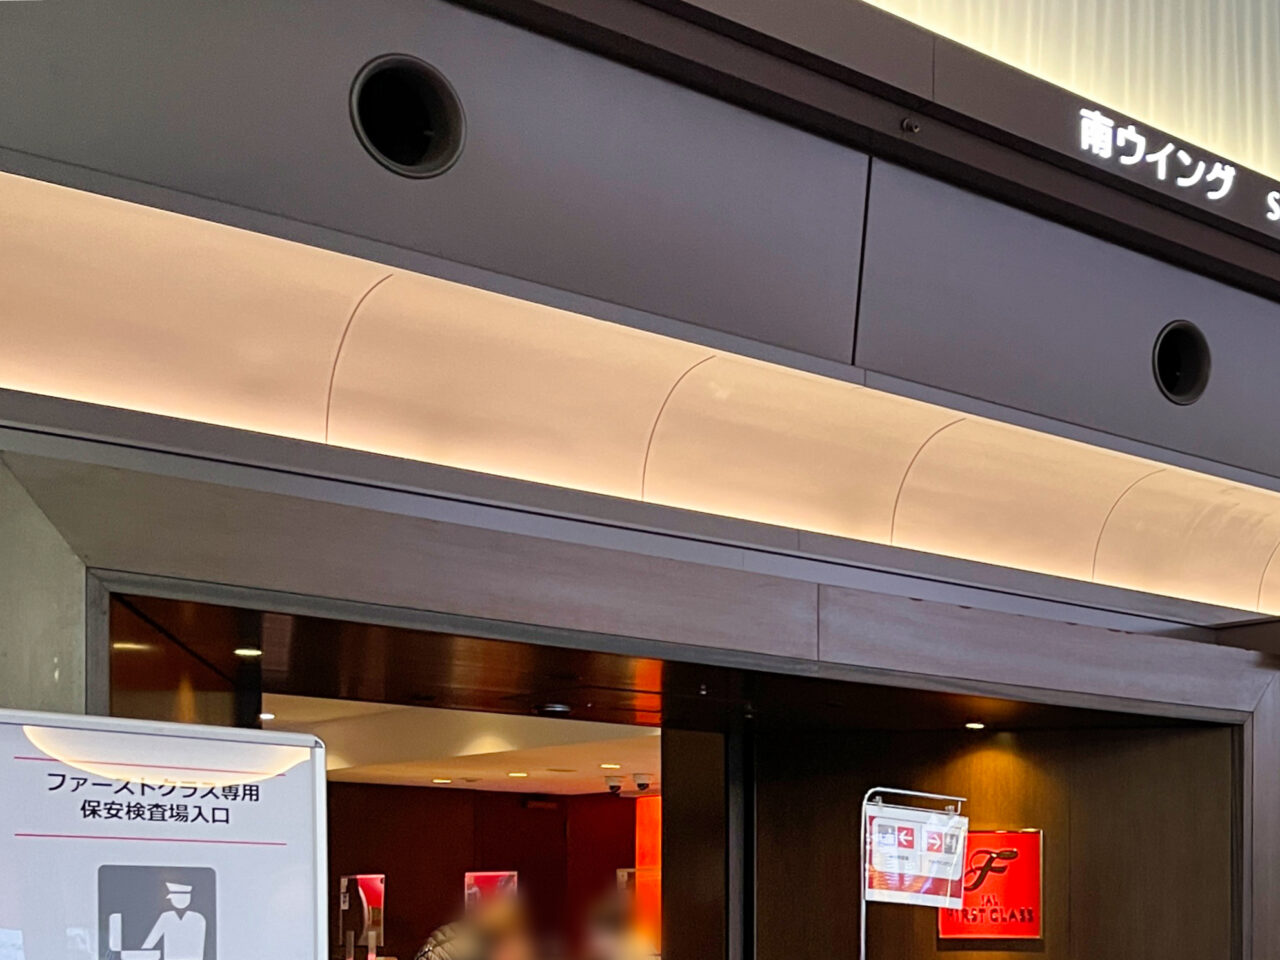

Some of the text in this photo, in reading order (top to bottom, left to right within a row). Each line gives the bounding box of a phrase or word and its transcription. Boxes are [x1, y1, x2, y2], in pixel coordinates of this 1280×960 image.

[1080, 108, 1236, 200] 南ウイング
[47, 772, 261, 802] ファーストクラス専用
[80, 799, 231, 825] 保安検査場入口
[989, 906, 1034, 923] CLASS
